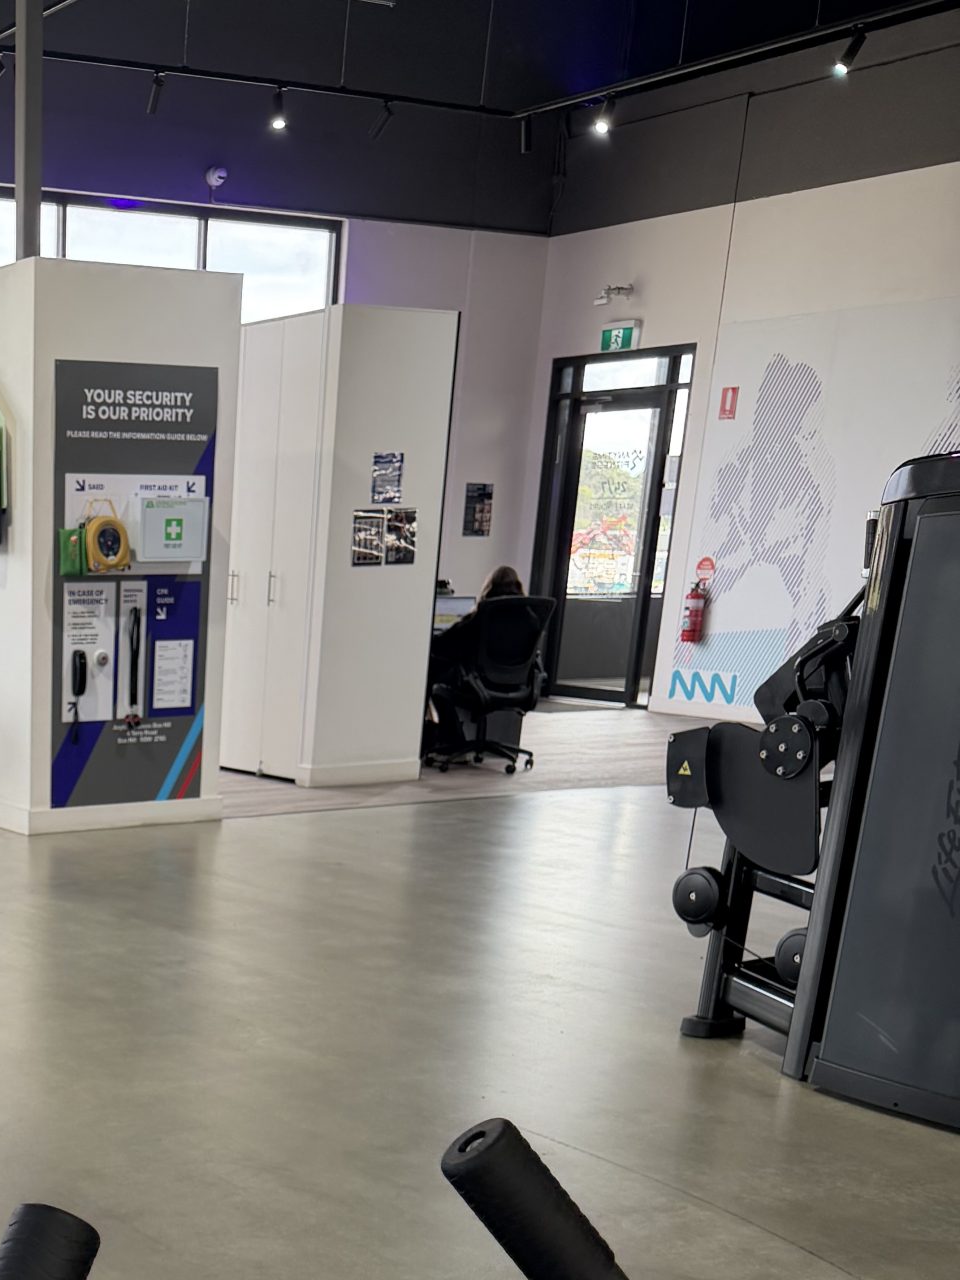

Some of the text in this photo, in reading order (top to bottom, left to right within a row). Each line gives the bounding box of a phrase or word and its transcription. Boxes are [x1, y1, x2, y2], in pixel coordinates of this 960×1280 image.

[84, 388, 193, 406] YOUR SECURITY
[82, 405, 194, 422] IS OUR PRIORITY
[66, 430, 90, 438] PLEASE
[91, 431, 108, 439] READ
[121, 432, 166, 440] INFORMATION
[166, 433, 185, 441] GUIDE
